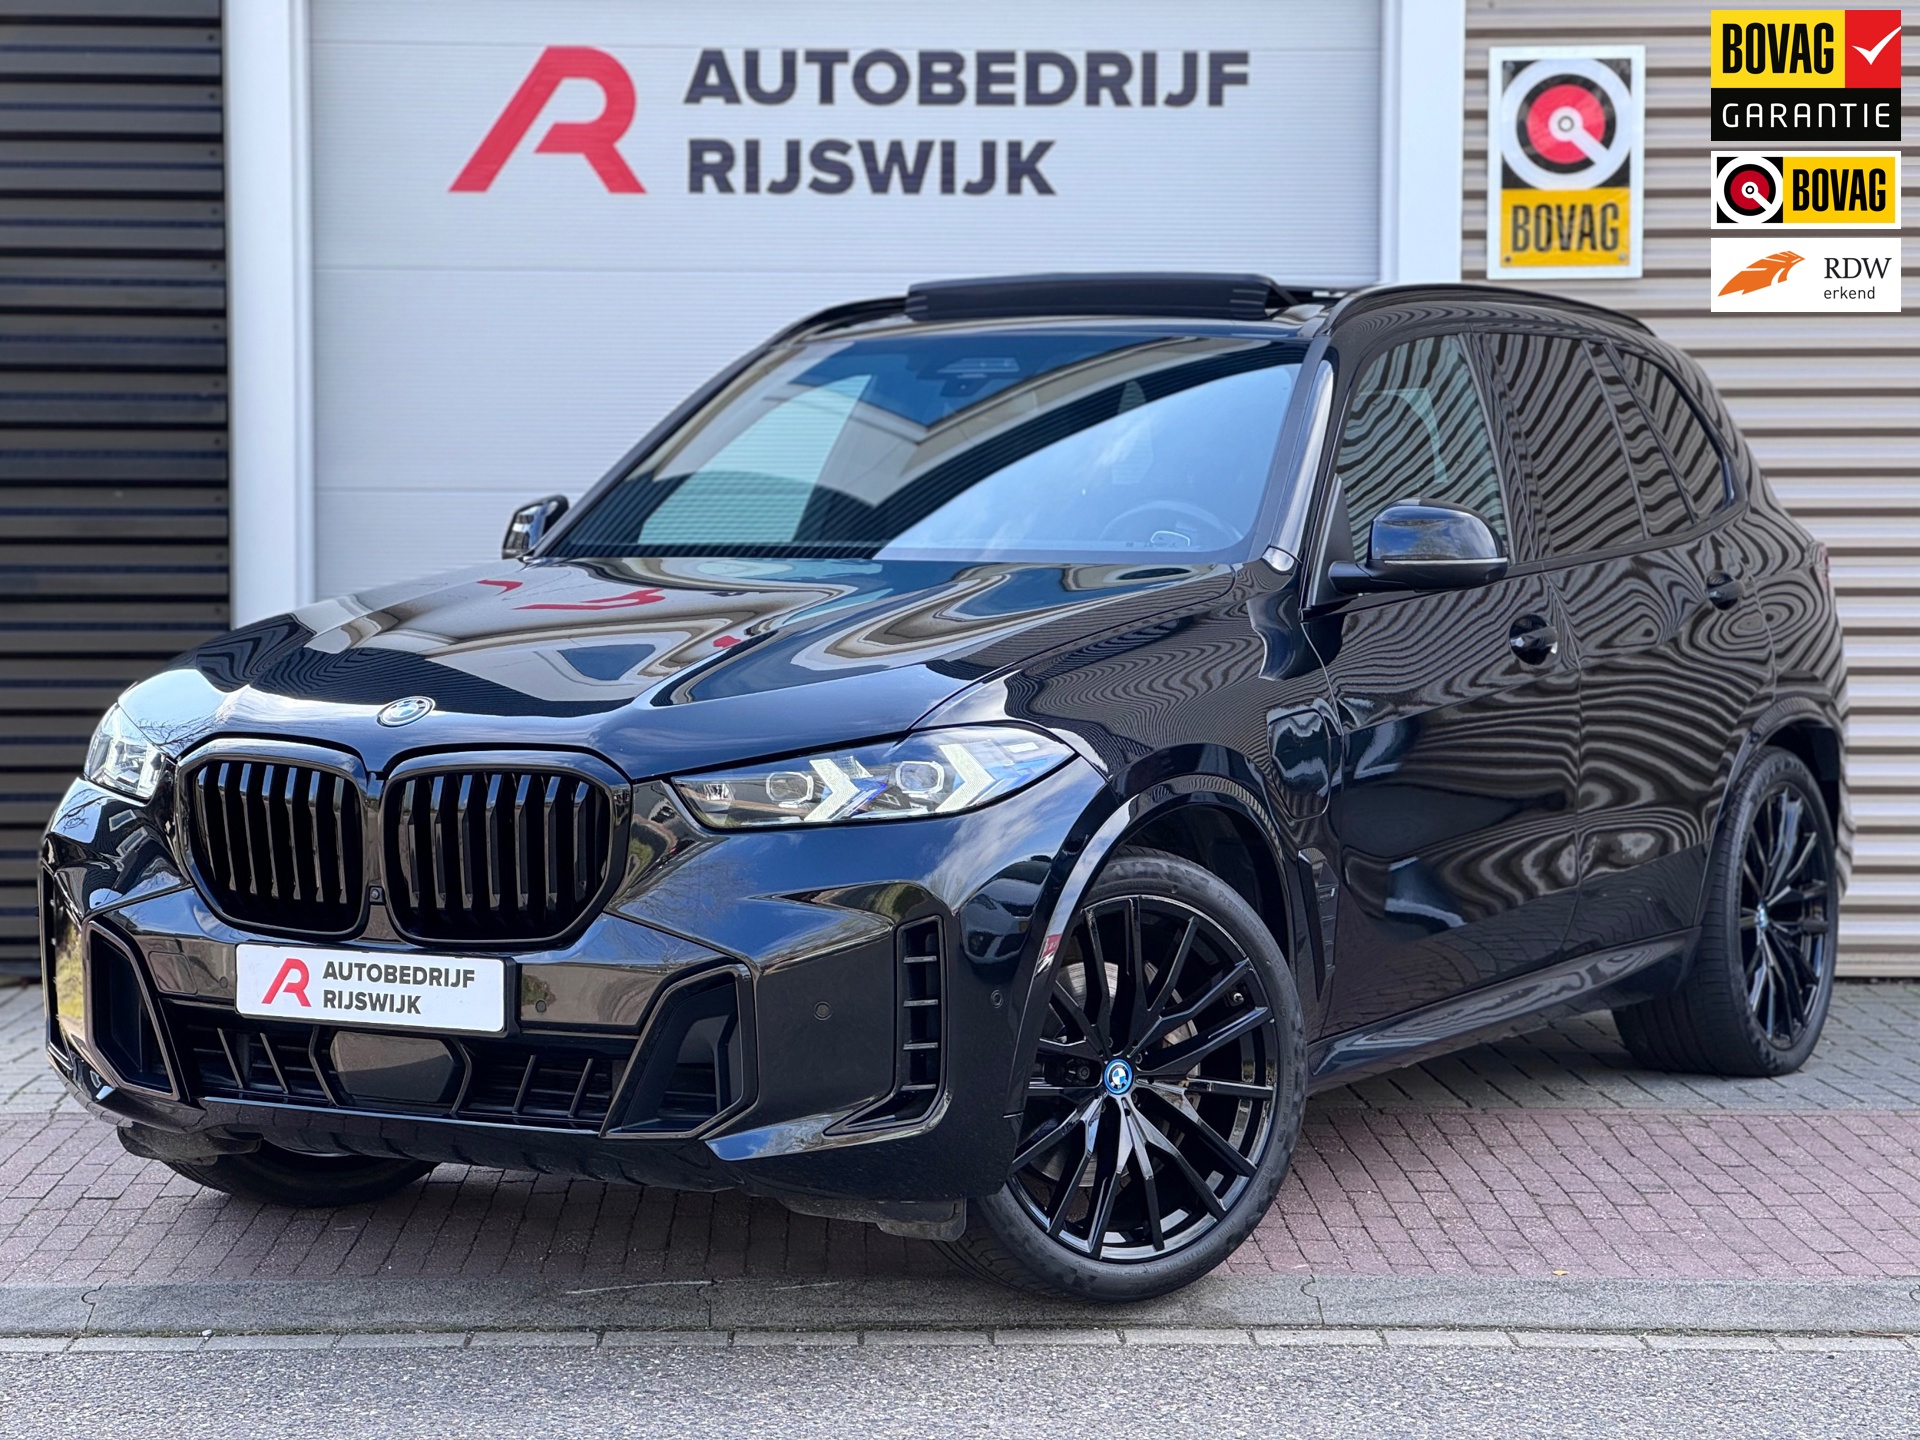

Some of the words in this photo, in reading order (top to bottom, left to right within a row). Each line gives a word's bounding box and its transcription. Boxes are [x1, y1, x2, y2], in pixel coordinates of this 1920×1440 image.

[684, 48, 1250, 107] AUTOBEDRIJF
[688, 138, 1057, 196] RIJSWIJK
[1511, 202, 1620, 252] BOVAG
[322, 960, 476, 989] AUTOBEDRIJF
[322, 989, 422, 1015] RIJSWIJK
